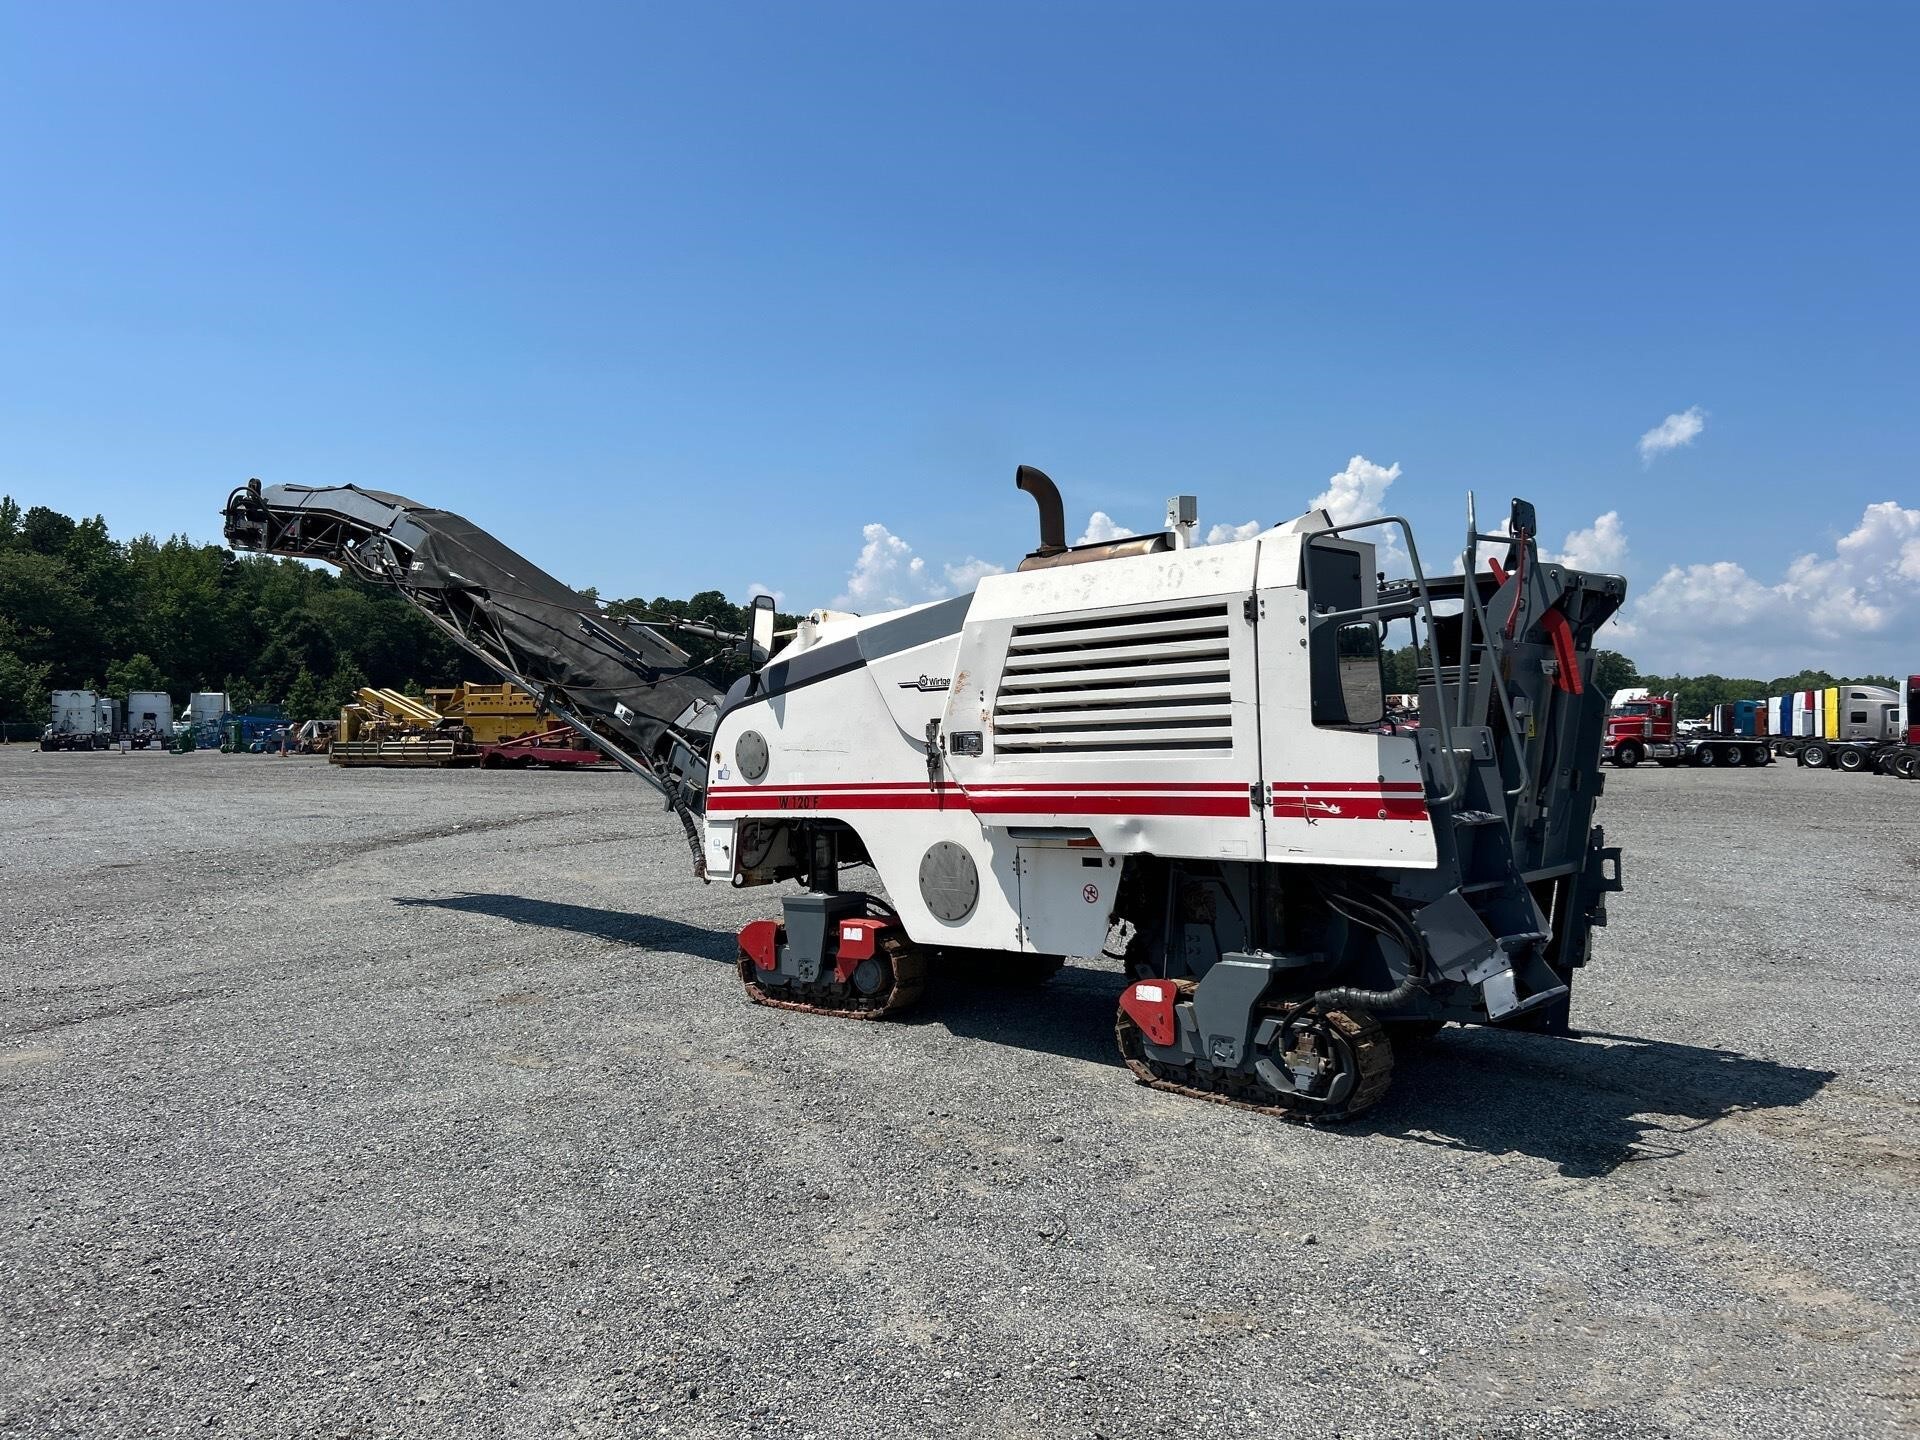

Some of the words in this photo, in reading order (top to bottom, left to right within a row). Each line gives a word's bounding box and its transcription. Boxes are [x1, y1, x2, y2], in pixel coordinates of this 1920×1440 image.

[778, 796, 789, 809] W
[792, 796, 809, 809] 120
[813, 796, 819, 809] F
